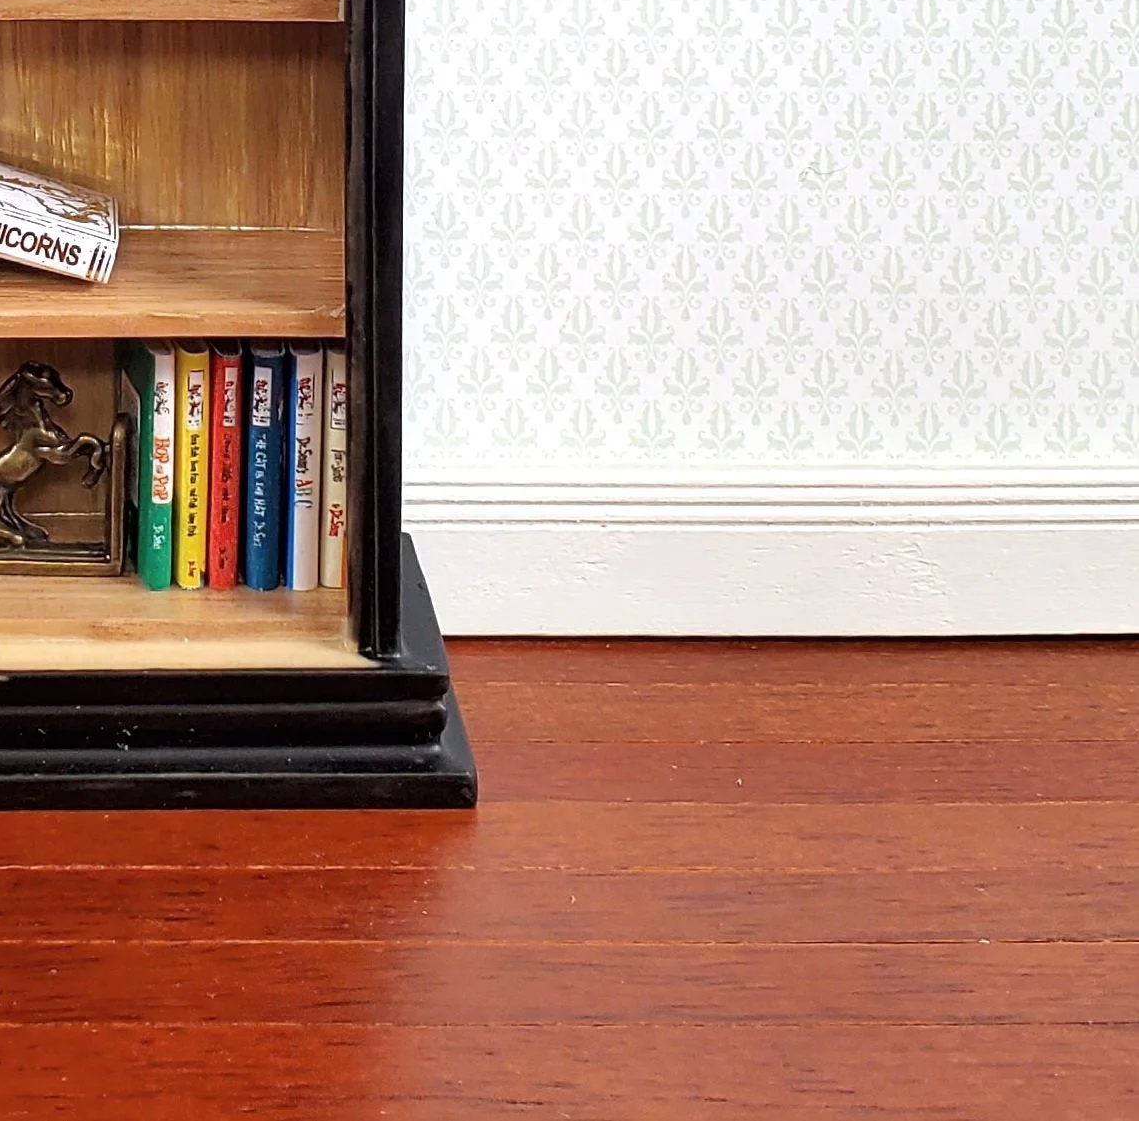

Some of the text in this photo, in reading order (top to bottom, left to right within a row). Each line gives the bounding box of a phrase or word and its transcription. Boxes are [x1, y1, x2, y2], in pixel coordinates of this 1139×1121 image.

[155, 436, 170, 463] HOP
[254, 452, 267, 469] CAT
[154, 475, 169, 500] POP
[253, 498, 266, 517] HAT
